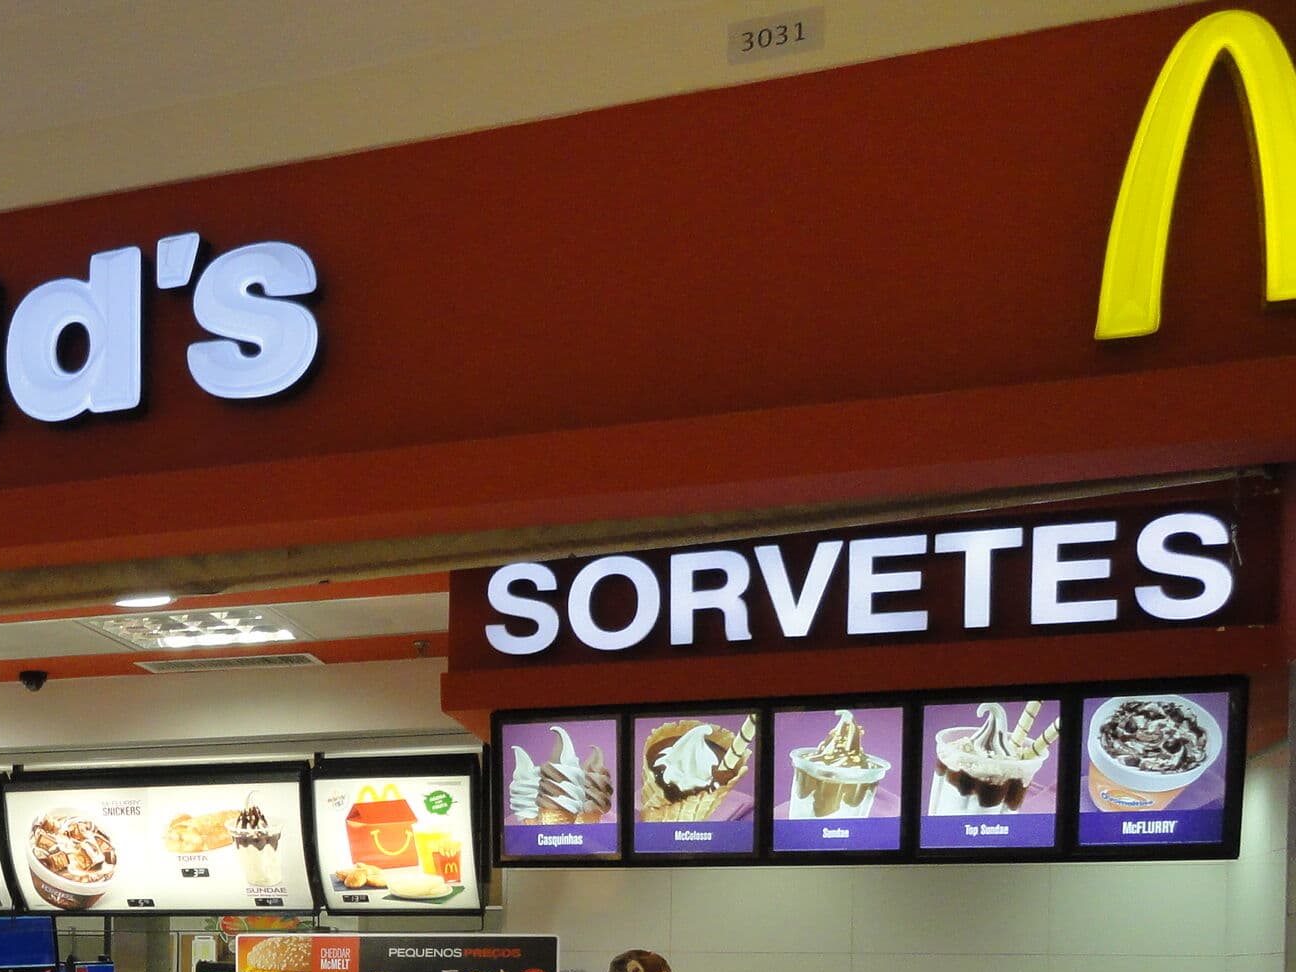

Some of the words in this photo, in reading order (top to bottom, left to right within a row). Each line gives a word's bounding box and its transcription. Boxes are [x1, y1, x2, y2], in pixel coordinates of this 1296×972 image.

[741, 21, 806, 52] 3031
[484, 511, 1235, 656] SORVETES
[822, 827, 850, 839] Sundae
[964, 824, 979, 837] Top
[981, 824, 1009, 835] Sundae
[1122, 820, 1175, 835] McFLURRY
[537, 834, 584, 847] Casquinhas
[320, 948, 351, 958] CHEDDAR
[388, 948, 463, 959] PEQUENOS
[320, 958, 351, 970] McMELT
